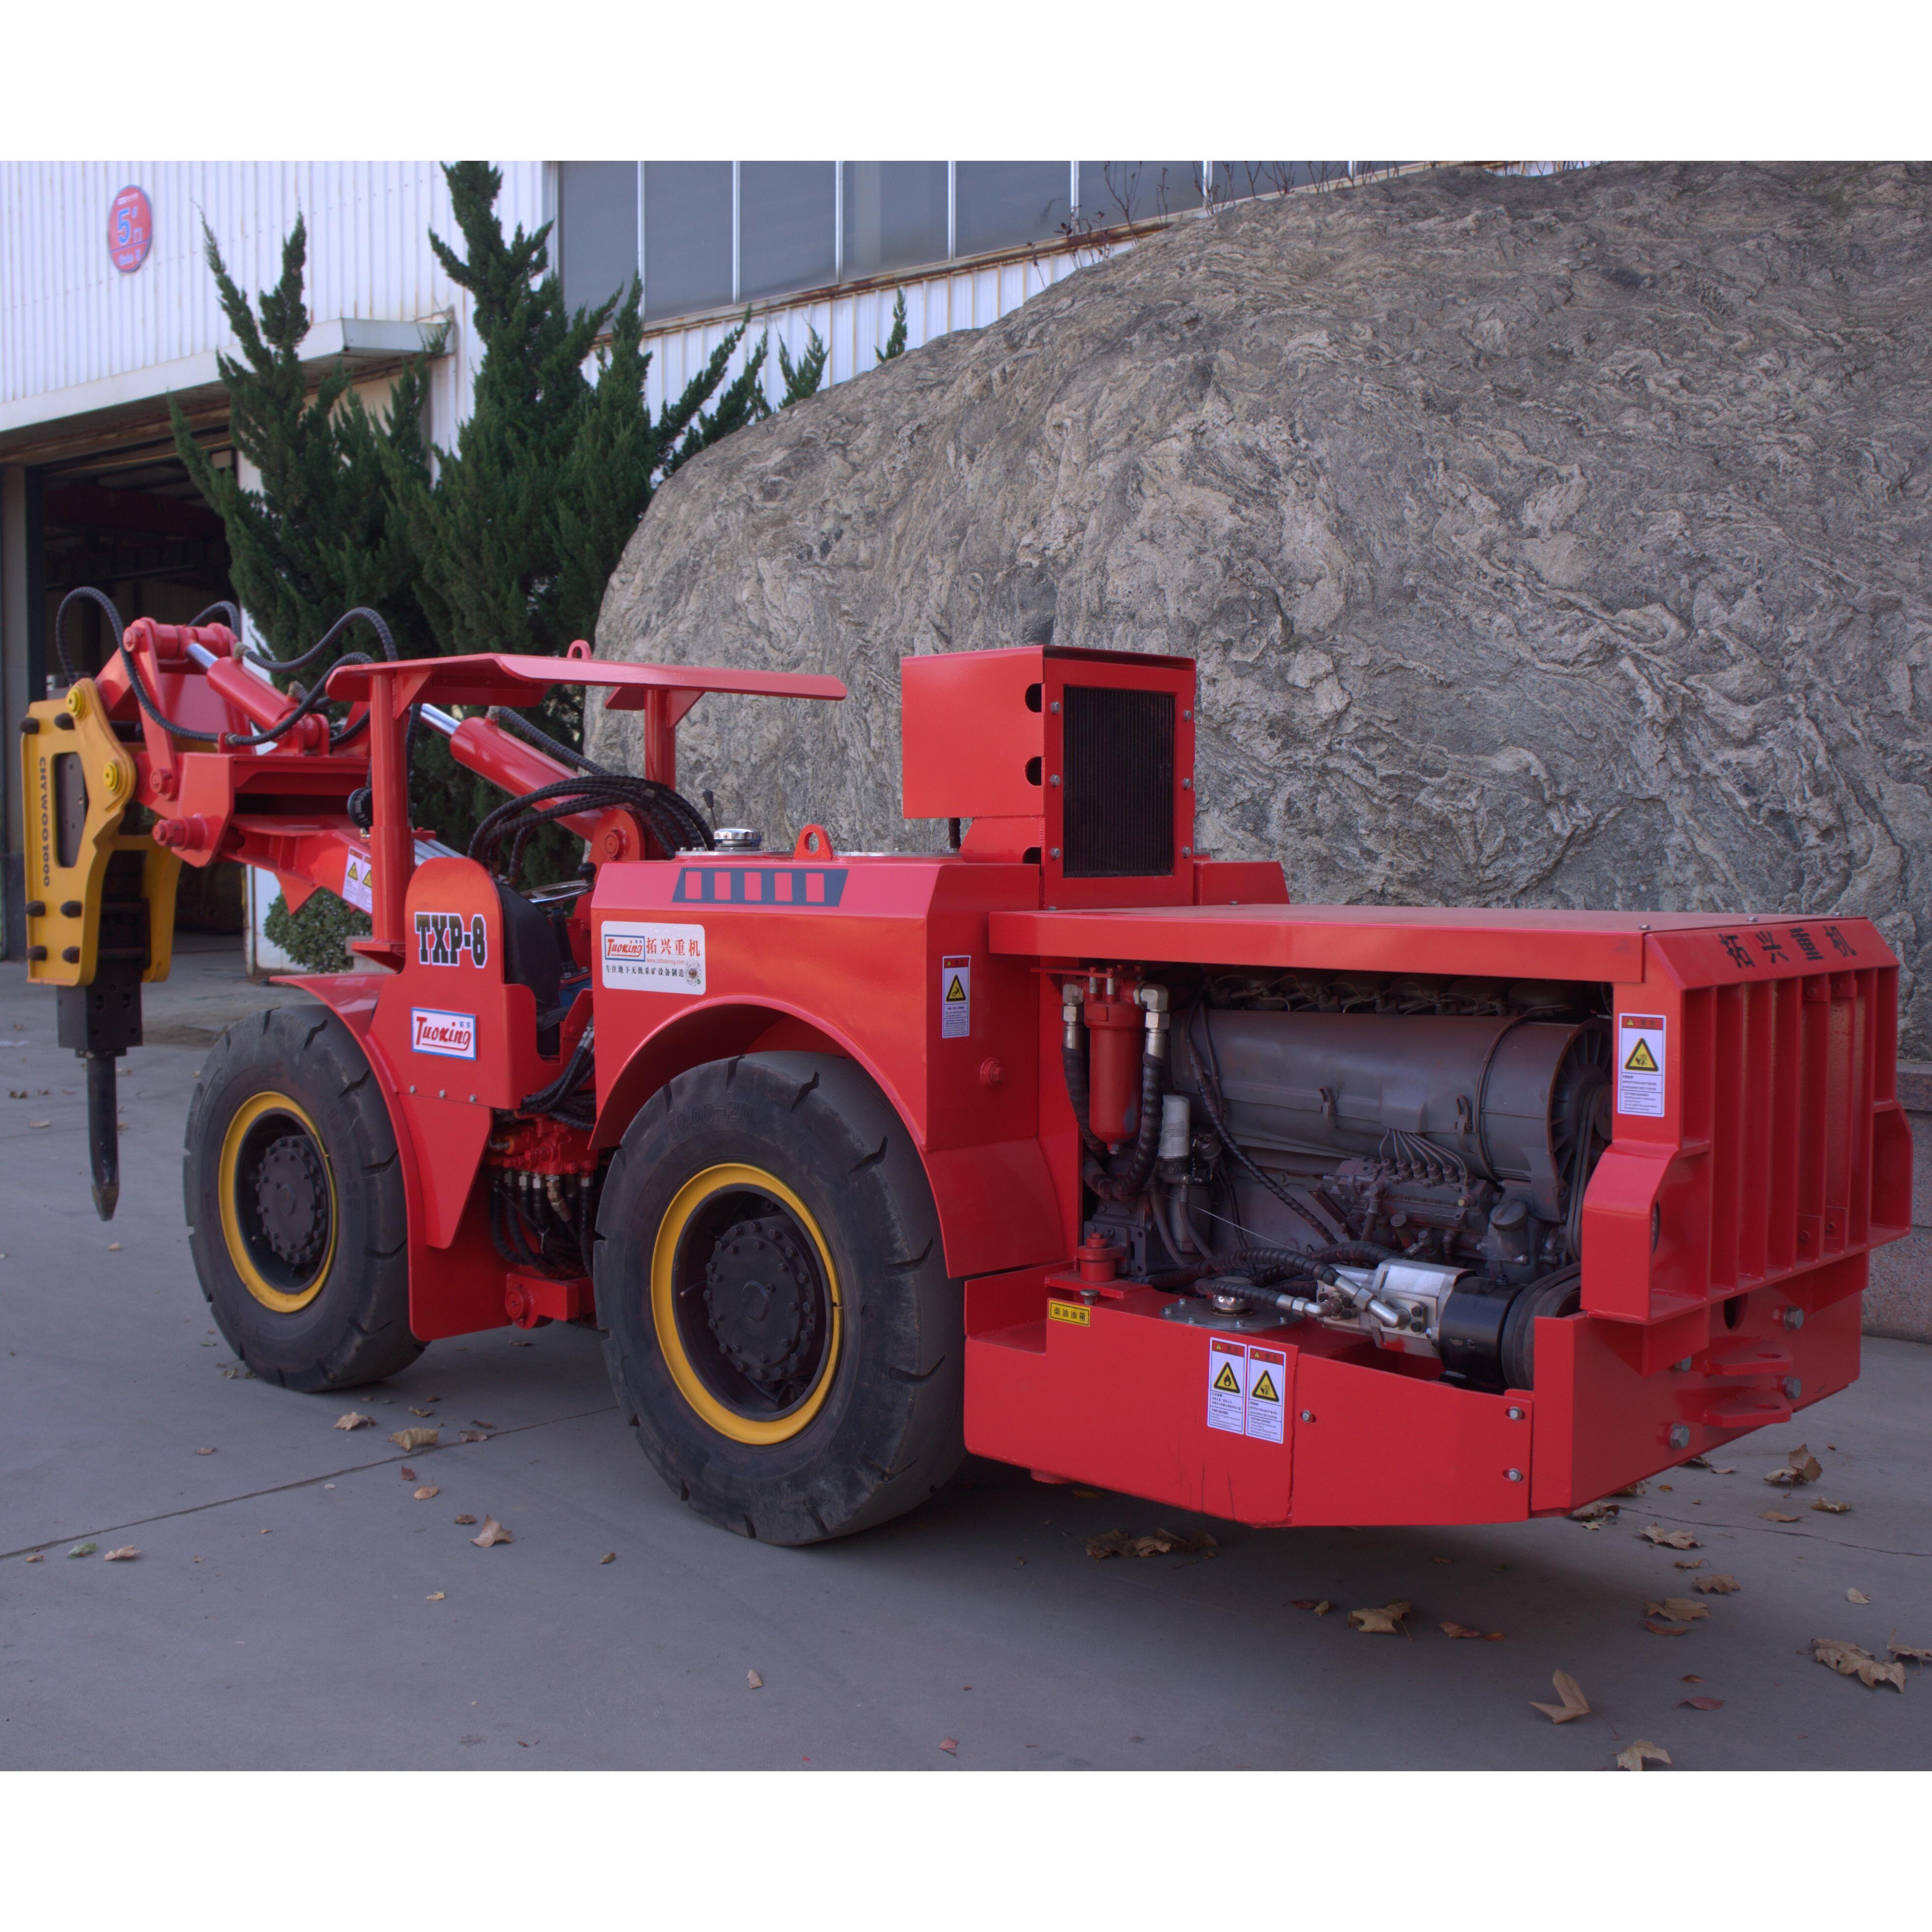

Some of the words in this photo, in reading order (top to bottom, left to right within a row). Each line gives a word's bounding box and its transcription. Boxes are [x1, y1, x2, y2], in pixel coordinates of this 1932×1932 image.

[414, 911, 487, 968] TXP-8
[607, 938, 643, 958] Tuoxing
[646, 937, 701, 957] 拓兴重机
[1718, 926, 1857, 968] 拓兴重机
[606, 965, 684, 977] 专注地下无轨采矿设备制造
[416, 1016, 471, 1051] Tuoxing
